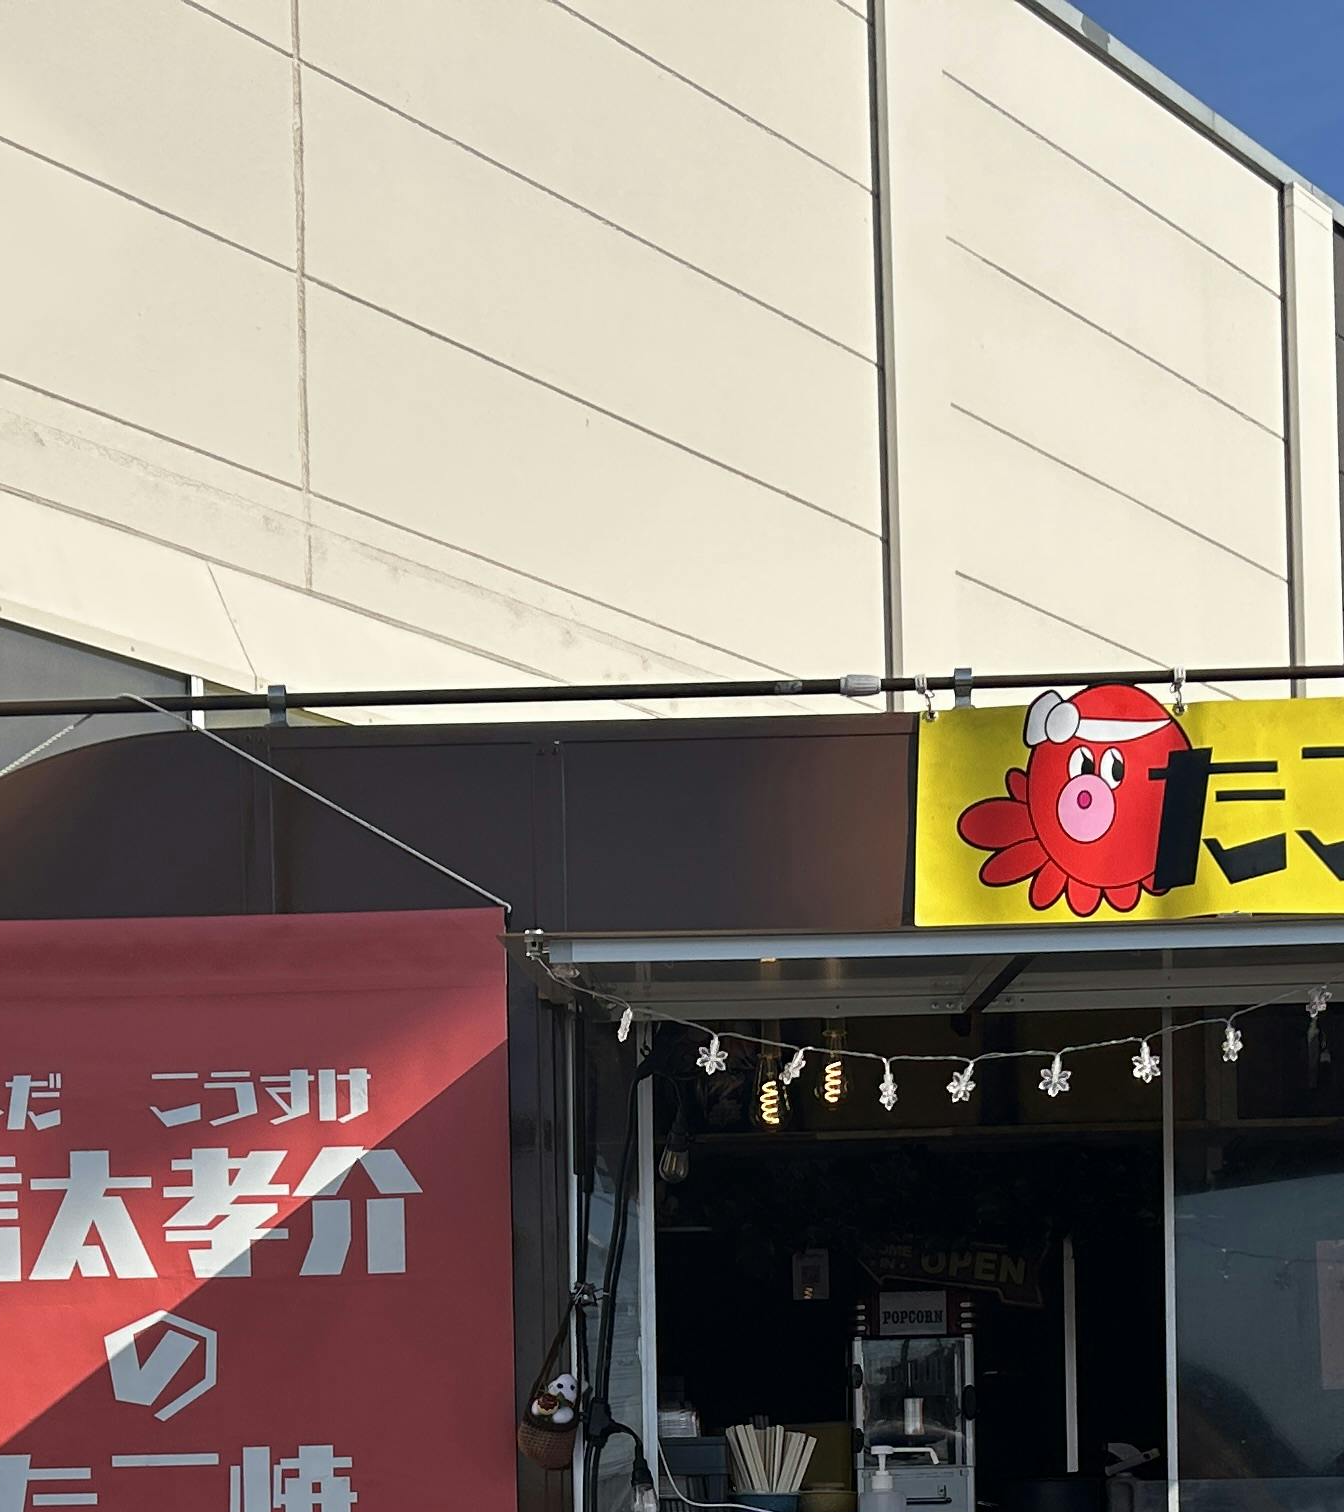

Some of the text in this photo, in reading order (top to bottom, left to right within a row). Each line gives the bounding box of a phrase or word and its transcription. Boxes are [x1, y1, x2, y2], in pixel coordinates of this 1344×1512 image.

[150, 1068, 373, 1129] こうすけ
[882, 1309, 944, 1325] POPCORN
[103, 1310, 219, 1422] の
